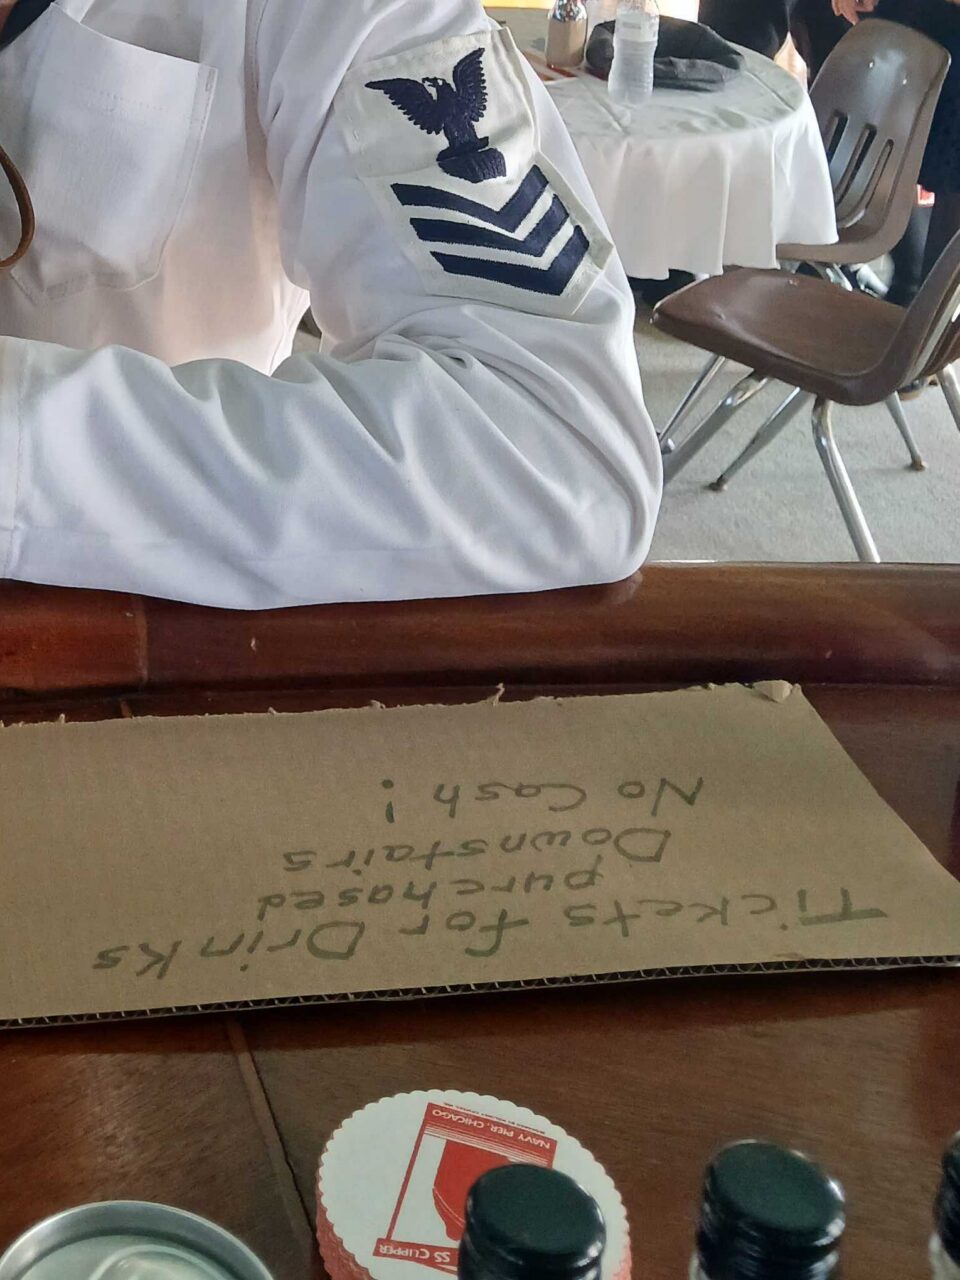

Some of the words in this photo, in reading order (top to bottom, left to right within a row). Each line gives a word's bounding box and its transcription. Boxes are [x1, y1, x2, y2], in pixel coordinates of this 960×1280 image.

[617, 776, 704, 817] No
[283, 827, 672, 877] Downstairs
[256, 855, 604, 921] purchased
[398, 907, 530, 959] for
[562, 886, 888, 939] Tickets
[432, 1108, 485, 1129] CHICAGO
[517, 1134, 551, 1150] NAVY
[379, 1243, 430, 1260] CLIPPER
[434, 1251, 451, 1263] SS
